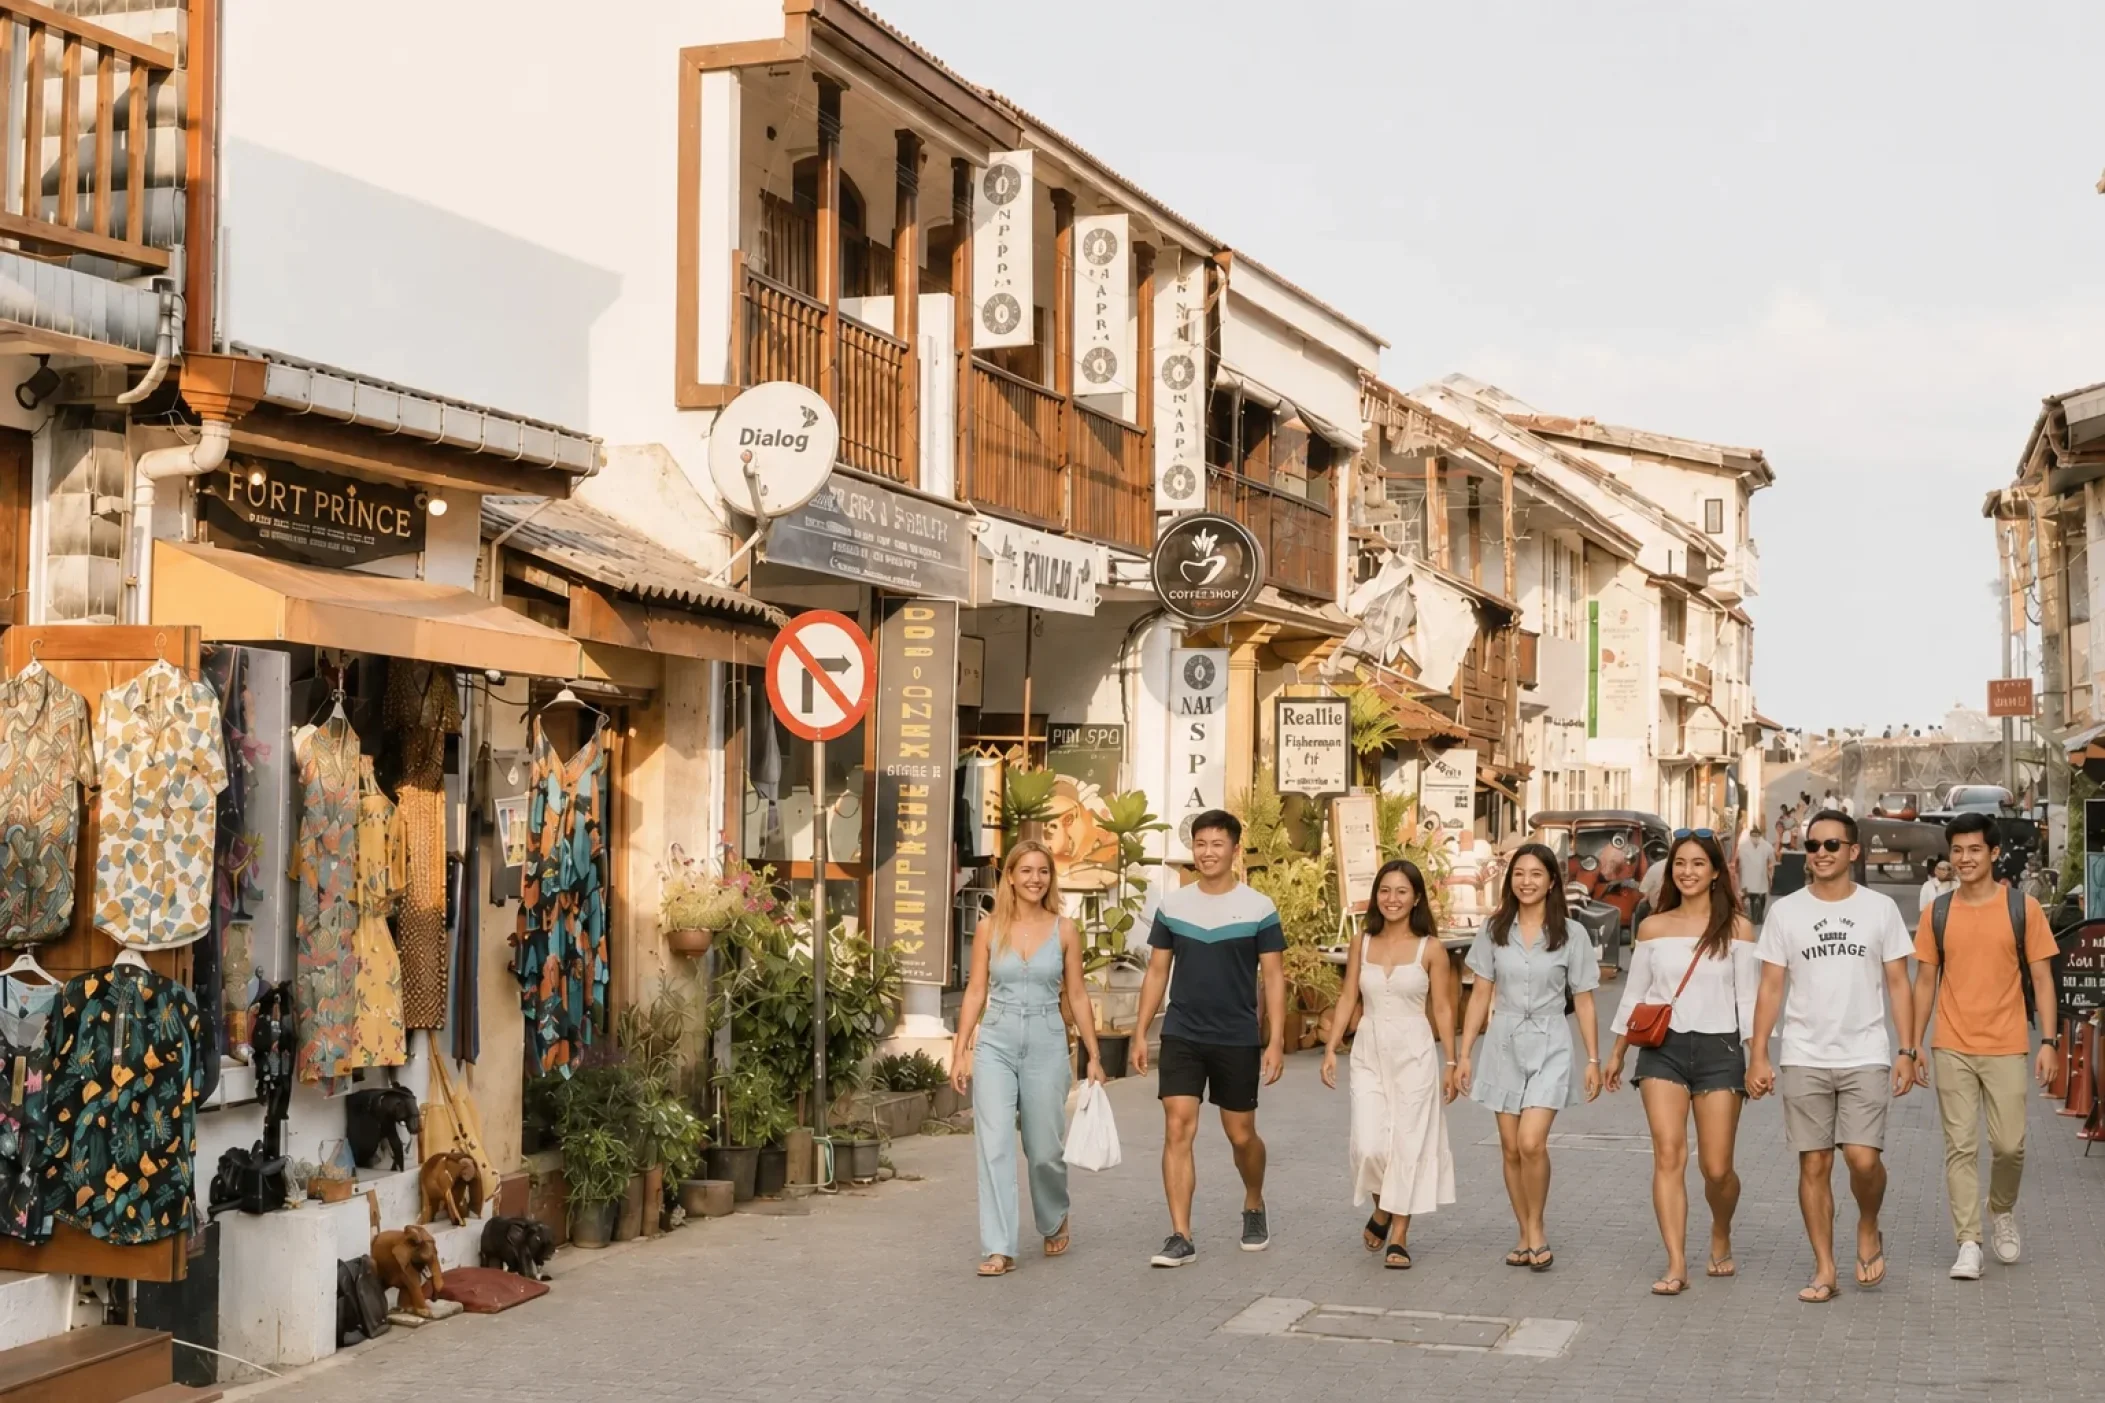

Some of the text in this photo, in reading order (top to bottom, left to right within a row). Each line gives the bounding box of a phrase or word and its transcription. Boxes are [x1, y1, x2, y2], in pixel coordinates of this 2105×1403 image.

[739, 427, 809, 453] Dialog
[228, 472, 308, 516] FORT
[313, 489, 412, 538] PRINCE
[1283, 706, 1343, 726] Reallie
[1801, 943, 1867, 961] VINTAGE
